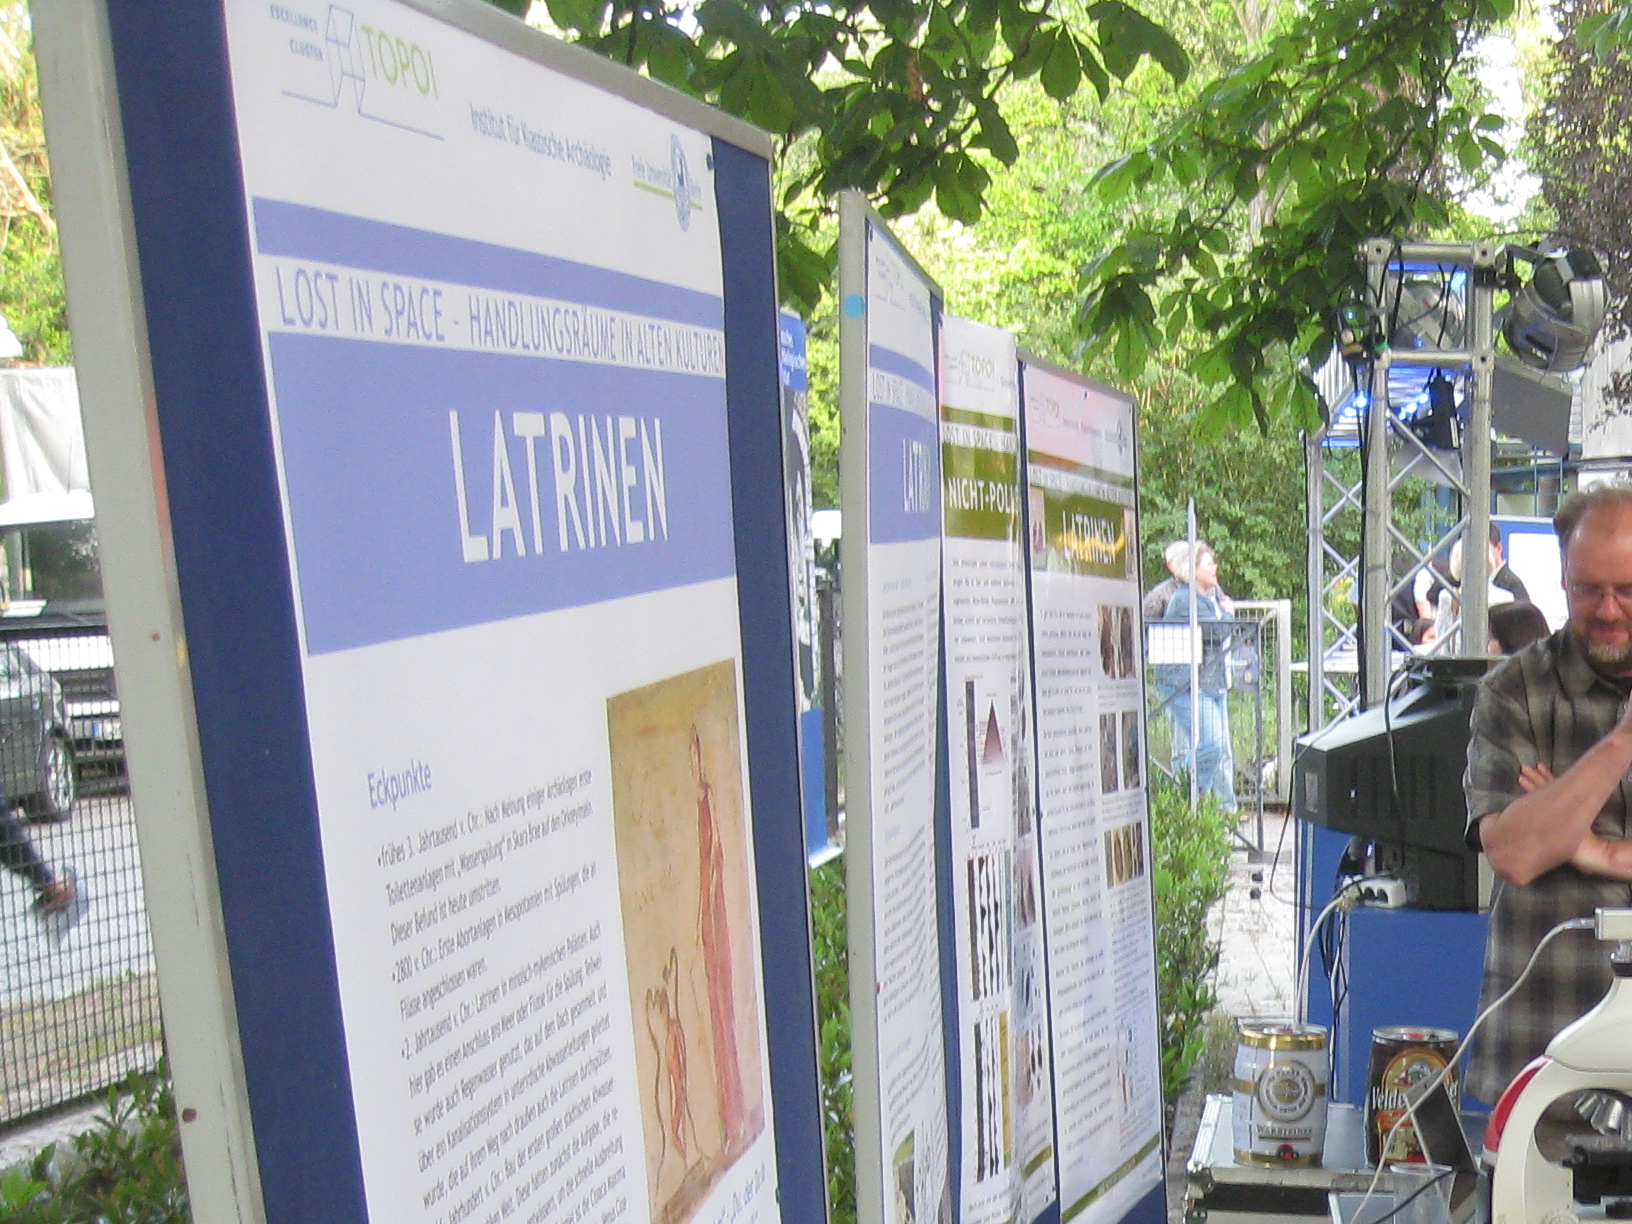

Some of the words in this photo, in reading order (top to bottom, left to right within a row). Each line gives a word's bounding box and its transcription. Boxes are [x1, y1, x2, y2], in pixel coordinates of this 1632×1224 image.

[361, 24, 438, 100] TOPOI
[276, 266, 340, 329] LOST
[349, 274, 374, 335] IN
[381, 280, 446, 342] SPACE
[468, 294, 618, 361] HANDLUNGSRÄUME
[620, 318, 634, 362] IN
[637, 322, 674, 370] ALTEN
[448, 408, 669, 564] LATRINEN
[1062, 510, 1117, 566] LATRINEN
[366, 757, 433, 812] Eckpunkte
